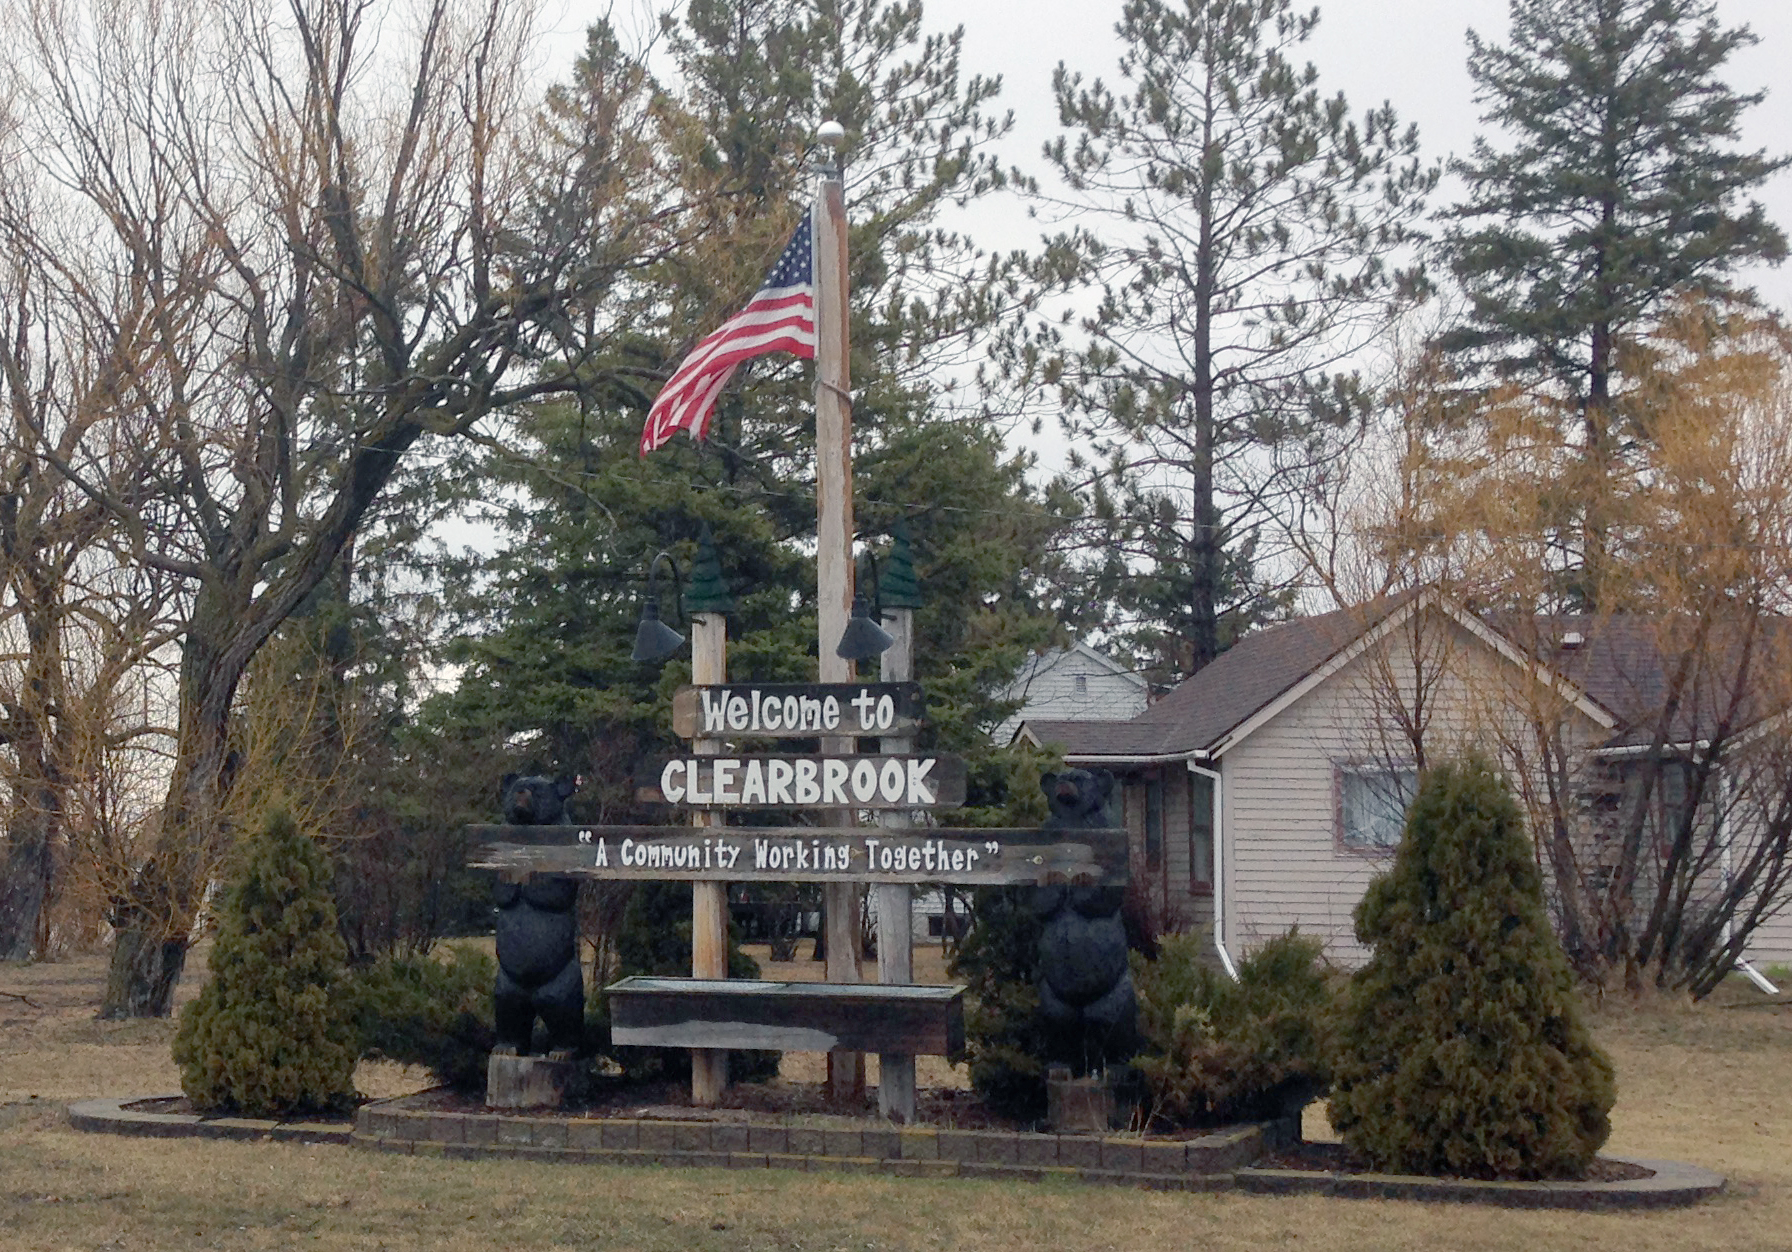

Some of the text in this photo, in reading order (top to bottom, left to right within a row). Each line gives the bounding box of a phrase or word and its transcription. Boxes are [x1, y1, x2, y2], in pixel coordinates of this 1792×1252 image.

[701, 688, 894, 731] Welcome to
[660, 758, 936, 804] CLEARBROOK
[620, 838, 740, 868] Community
[754, 838, 850, 869] Working
